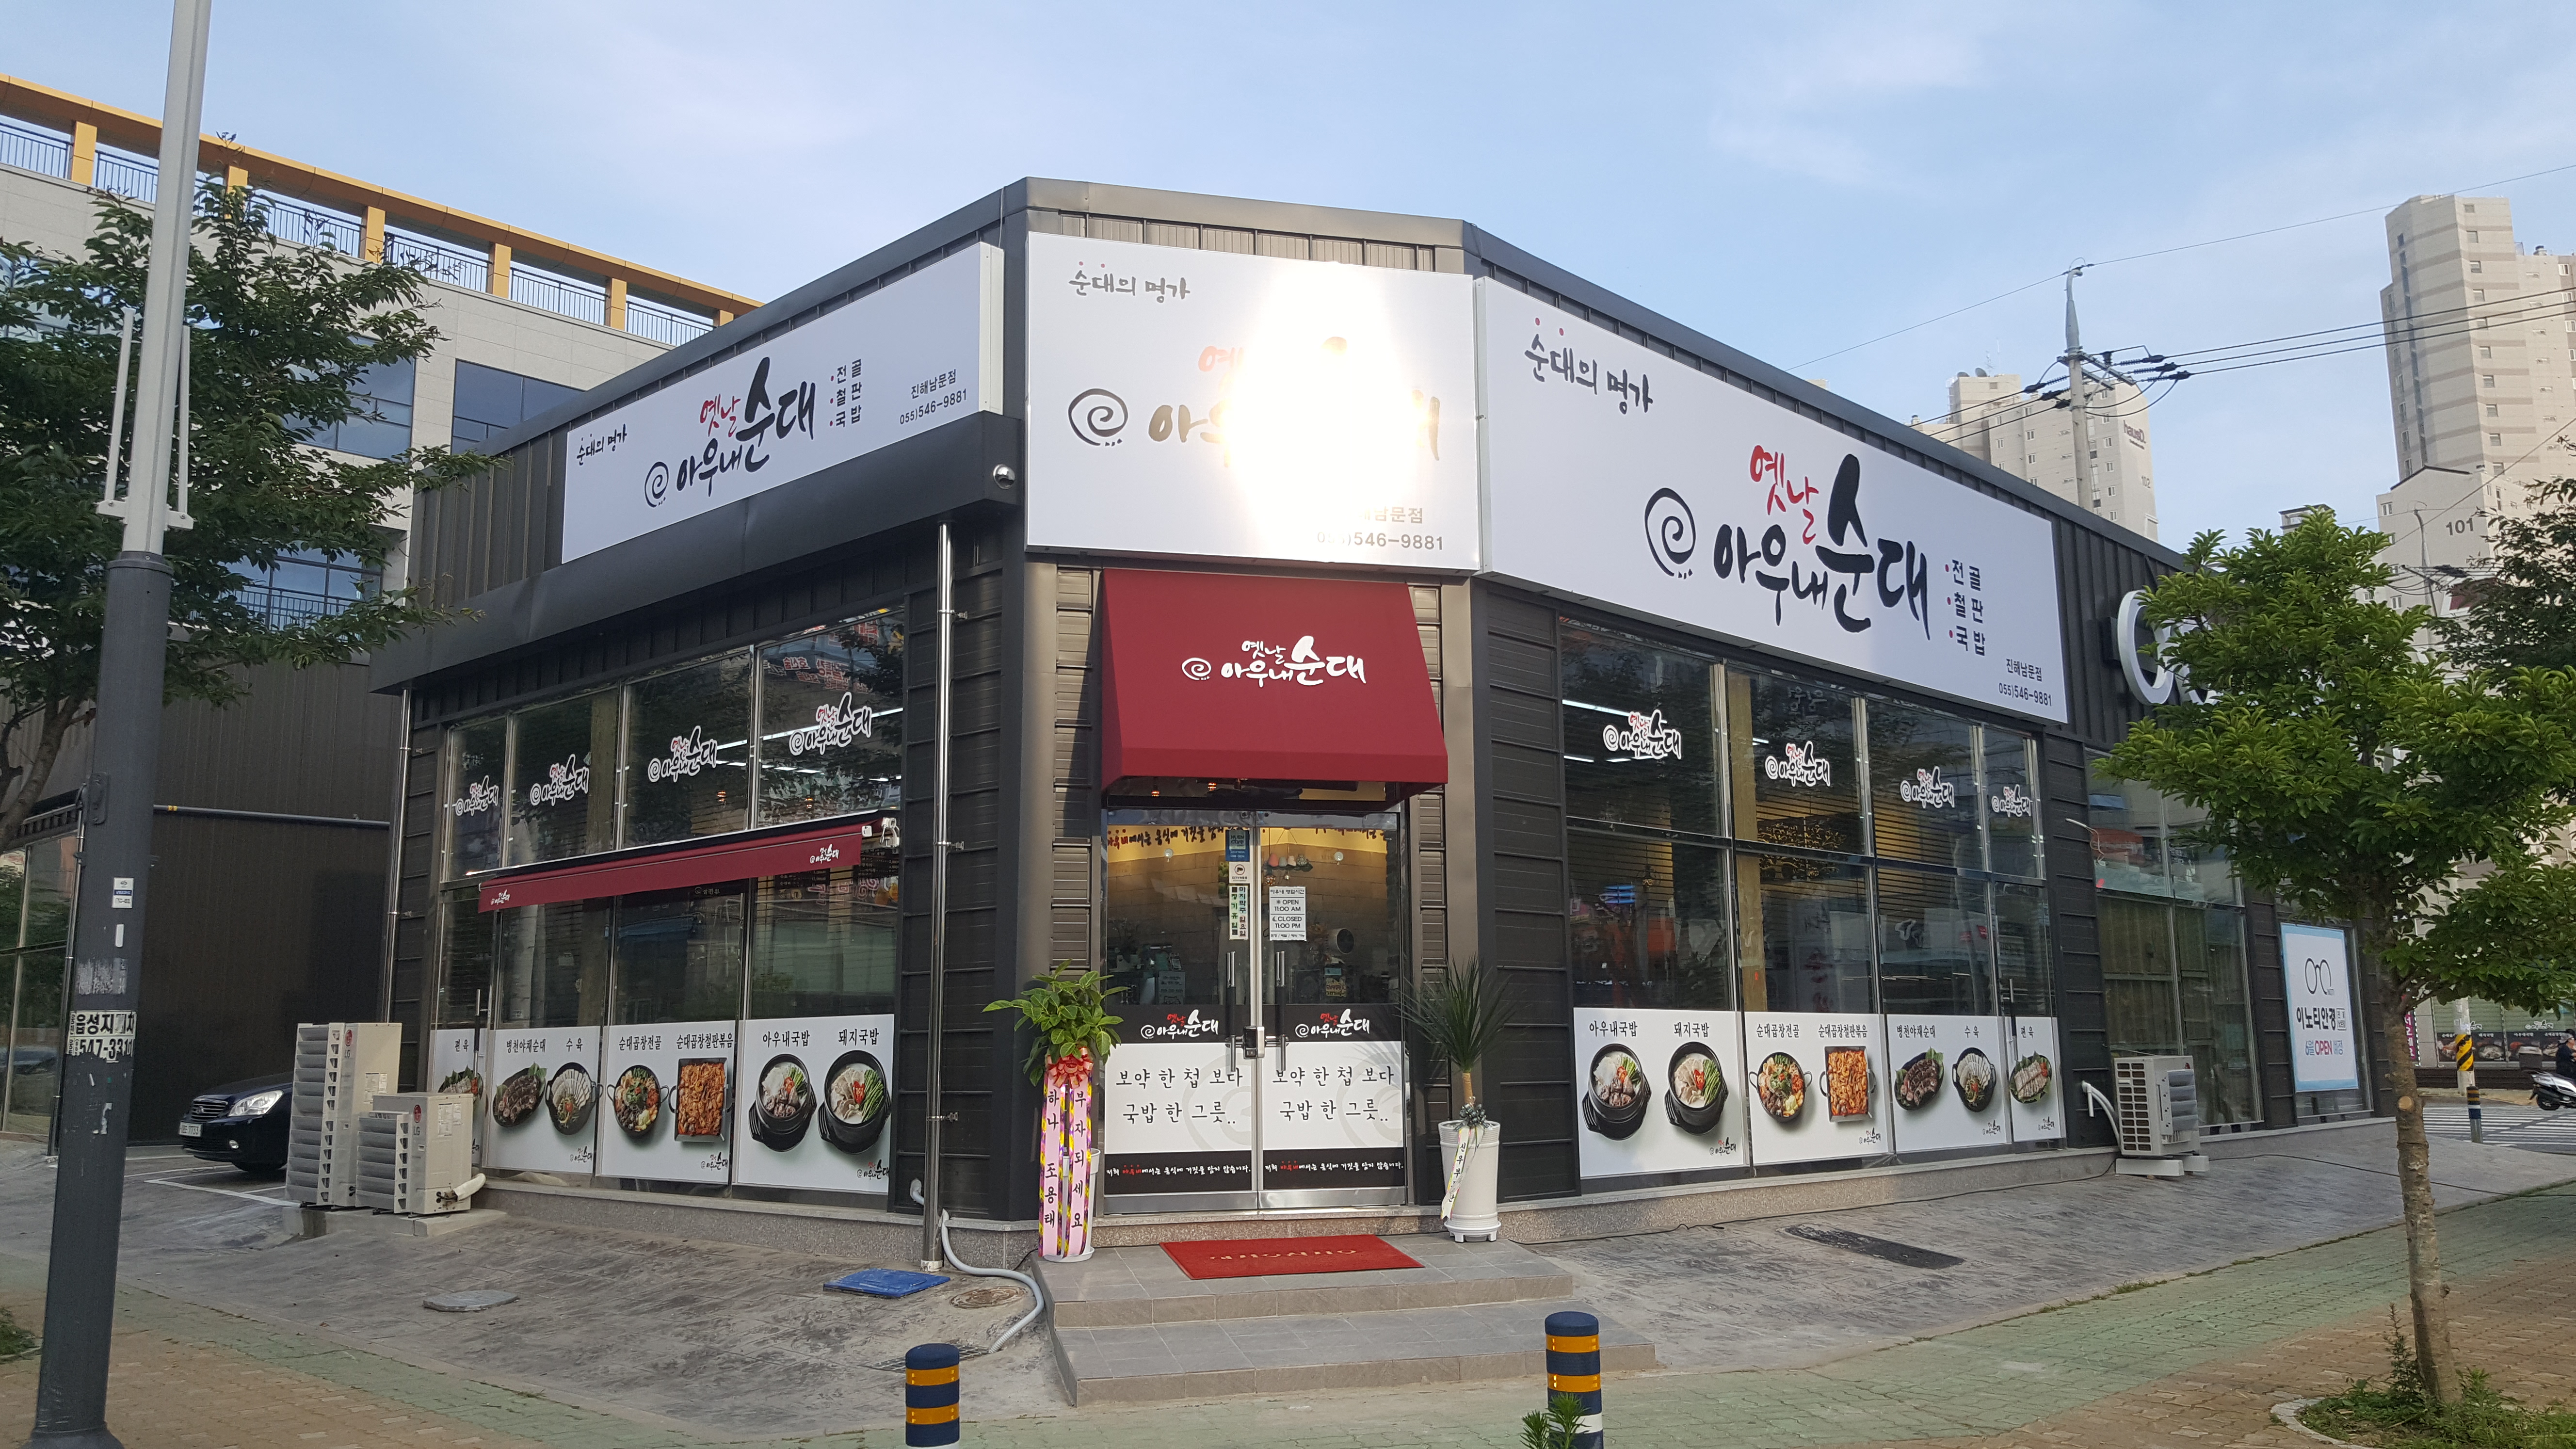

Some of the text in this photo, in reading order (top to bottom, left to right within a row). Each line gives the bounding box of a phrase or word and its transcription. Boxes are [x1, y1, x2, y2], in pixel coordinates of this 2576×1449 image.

[1068, 269, 1191, 304] 순대의 명가
[837, 358, 862, 384] 전골
[1525, 333, 1653, 416] 순대의 명가
[836, 382, 862, 406] 철판
[910, 369, 957, 400] 진해남문점
[699, 393, 741, 438] 옛날
[835, 404, 862, 428] 국밥
[899, 388, 968, 425] 055)546-9881
[676, 356, 816, 498] 아우내 순대
[576, 423, 628, 466] 순대의 명가
[1750, 445, 1819, 544] 옛날
[2446, 518, 2474, 536] 101
[1713, 454, 1932, 640] 아우내 순대
[1951, 559, 1982, 592] 전골
[1954, 592, 1985, 625] 철판
[1241, 640, 1287, 664] 옛날
[1955, 625, 1986, 657] 국밥
[1221, 635, 1366, 688] 아우내 순대
[2005, 657, 2043, 683] 진해남문점
[1998, 682, 2052, 708] 055)546-9881
[835, 692, 872, 746] 순대
[1647, 709, 1681, 759] 순대
[686, 725, 717, 775] 순대
[1802, 741, 1830, 786] 순대
[563, 754, 589, 800] 순대
[1931, 766, 1954, 808] 순대
[1157, 1009, 1218, 1040] 아우내 순대
[1310, 1009, 1370, 1039] 아우내 순대
[1589, 1020, 1638, 1038] 아우내국밥
[1674, 1022, 1709, 1038] 돼지국밥
[1756, 1023, 1800, 1038] 순대곱창전골
[2296, 1007, 2335, 1030] 이노티안경
[619, 1035, 662, 1051] 순대곱창전골
[676, 1032, 734, 1049] 순대곱창철판볶음
[762, 1030, 810, 1047] 아우내국밥
[838, 1028, 879, 1046] 돼지국밥
[1818, 1024, 1868, 1038] 순대곱창철판볶음
[1896, 1025, 1936, 1039] 병천야채순대
[1964, 1026, 1979, 1039] 수육
[2021, 1025, 2034, 1039] 편육
[454, 1039, 469, 1052] 편육
[506, 1038, 546, 1053] 병천야채순대
[565, 1037, 583, 1052] 수육
[2315, 1040, 2332, 1055] OPEN
[1115, 1067, 1243, 1090] 보약 한 첩 보다
[1272, 1065, 1395, 1087] 보약 한 첩 보다
[1123, 1103, 1158, 1125] 국밥
[1165, 1102, 1182, 1123] 한
[1279, 1100, 1313, 1122] 국밥
[1320, 1099, 1337, 1121] 한
[414, 1127, 420, 1136] LG
[1044, 1089, 1060, 1228] 하나 조용태
[1164, 1167, 1183, 1175] 음식에
[1186, 1166, 1205, 1175] 거짓을
[1208, 1165, 1220, 1174] 담지
[1341, 1162, 1359, 1171] 거짓을
[1362, 1162, 1374, 1171] 담지
